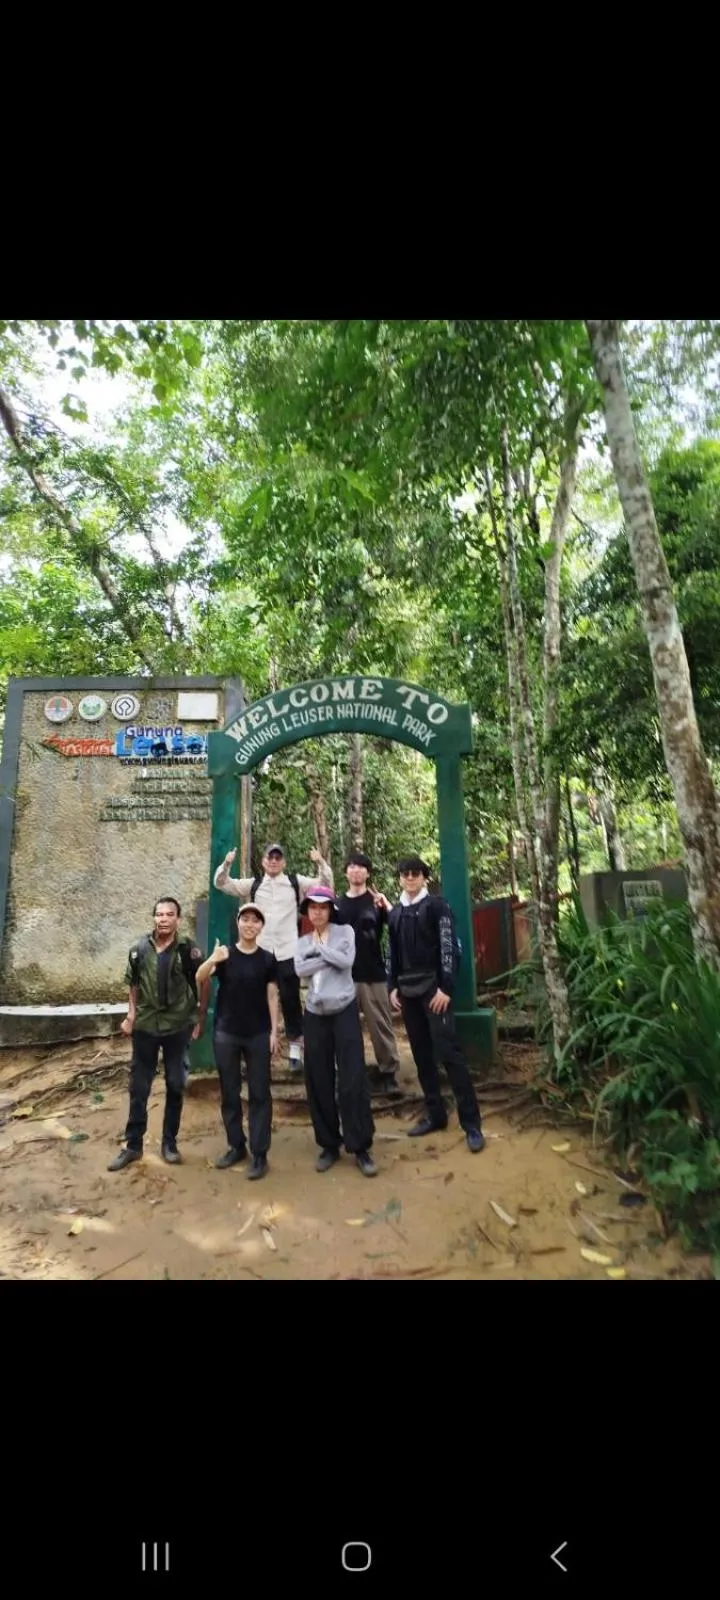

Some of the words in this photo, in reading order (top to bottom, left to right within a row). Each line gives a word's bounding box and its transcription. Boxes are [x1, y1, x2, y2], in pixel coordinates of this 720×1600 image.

[225, 679, 384, 743] WELCOME
[395, 685, 449, 725] TO
[235, 722, 281, 766] GUNUNG
[281, 704, 334, 732] LEUSER
[336, 702, 398, 726] NATIONAL
[402, 714, 438, 748] PARK
